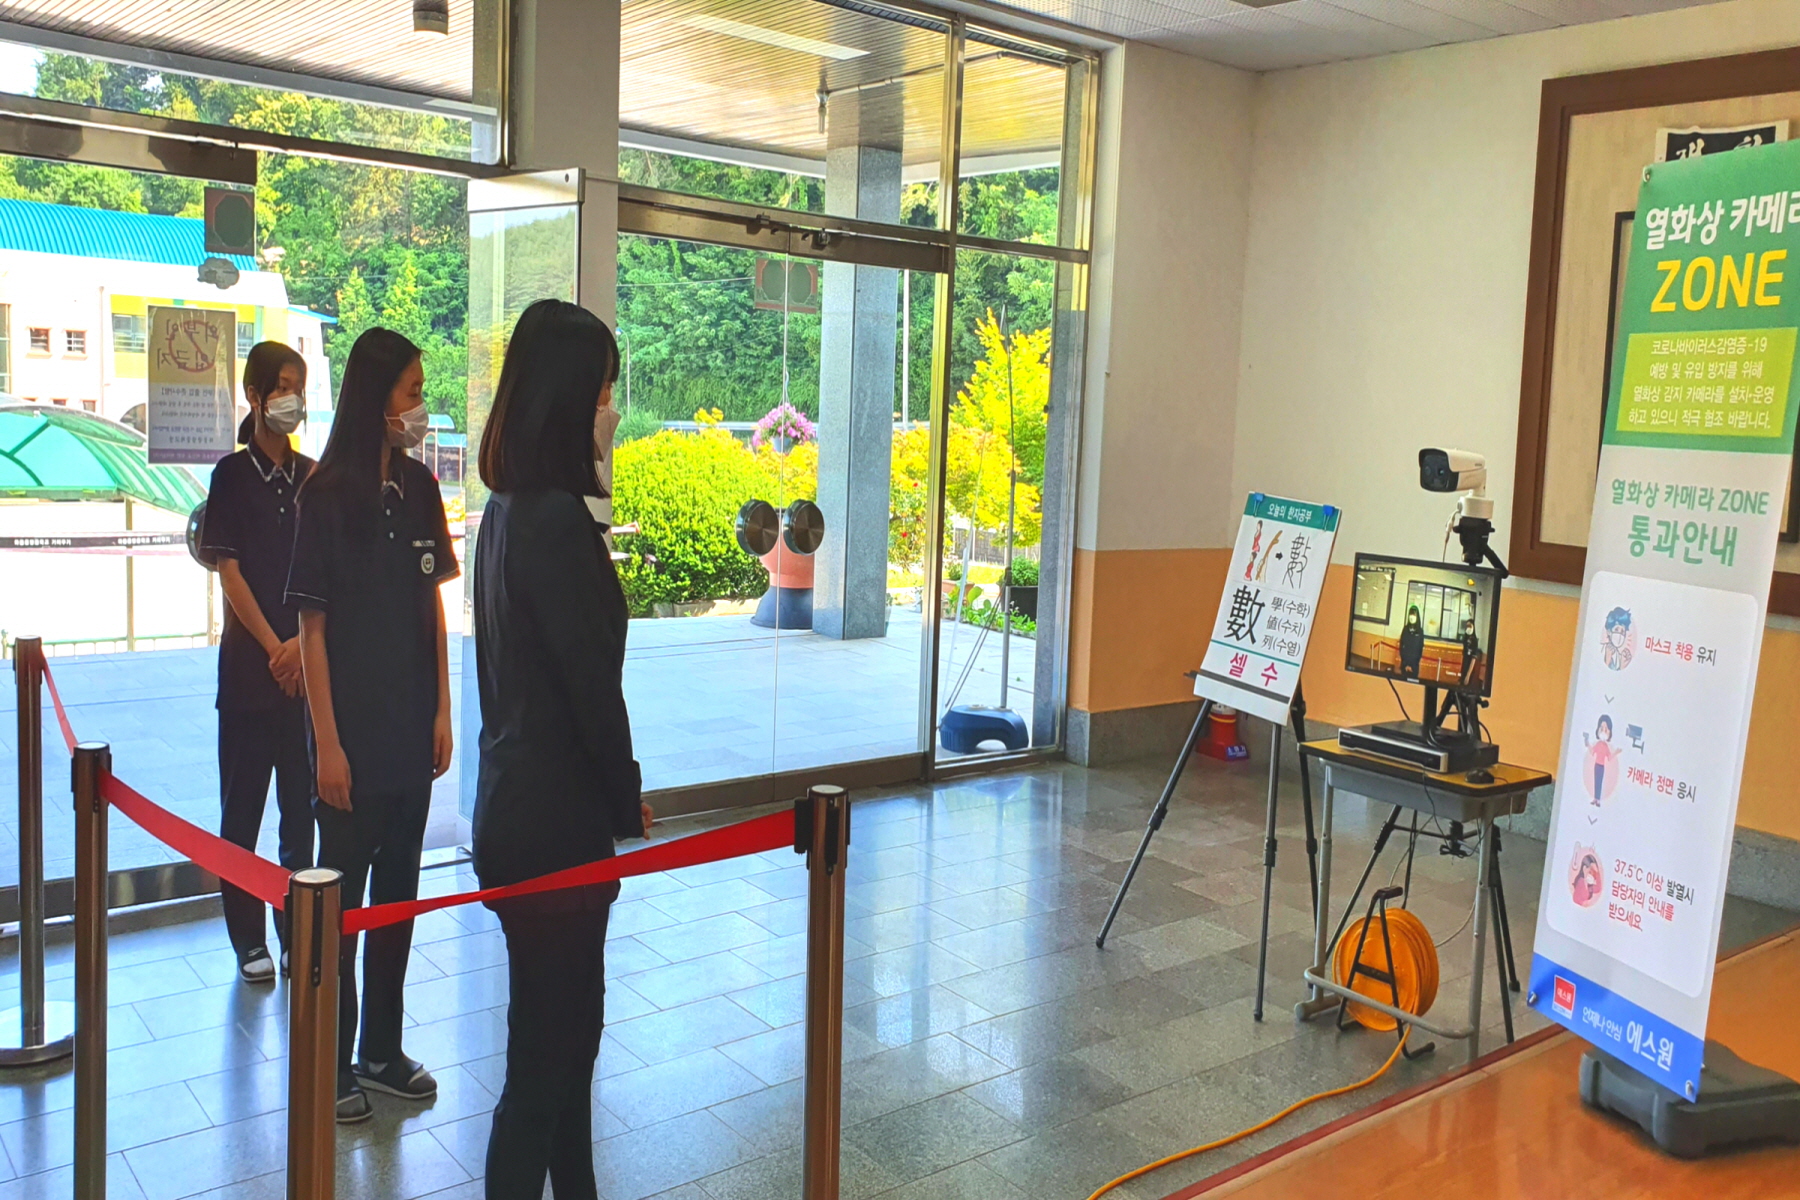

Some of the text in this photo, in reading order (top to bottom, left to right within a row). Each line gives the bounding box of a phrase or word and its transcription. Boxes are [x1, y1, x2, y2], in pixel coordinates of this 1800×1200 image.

[1646, 199, 1725, 249] 열화상
[1650, 249, 1787, 312] ZONE
[1651, 337, 1767, 355] 코로나바이러스감염증-19
[1650, 360, 1763, 379] 예방 및 유입 방지를 위해
[1634, 385, 1660, 403] 열화상
[1664, 385, 1683, 403] 감지
[1686, 385, 1725, 403] 카메라를
[1629, 408, 1771, 429] 하고 있으니 적극 협조 바랍니다.
[1267, 503, 1312, 523] 오늘의 한자공부
[1612, 478, 1769, 515] 열화상 카메라 ZONE
[1627, 515, 1738, 566] 통과안내
[1224, 585, 1265, 645] 數
[1645, 636, 1717, 666] 마스크 착용 유지
[1229, 652, 1278, 687] 셀 수
[1627, 766, 1696, 803] 카메라 정면 응시
[1612, 880, 1674, 921] 담당자의 안내를
[1646, 872, 1664, 892] 이상
[1667, 879, 1694, 905] 발열시
[1583, 1006, 1605, 1032] 언제나
[1606, 1020, 1622, 1042] 안심
[1626, 1021, 1674, 1072] 에스원
